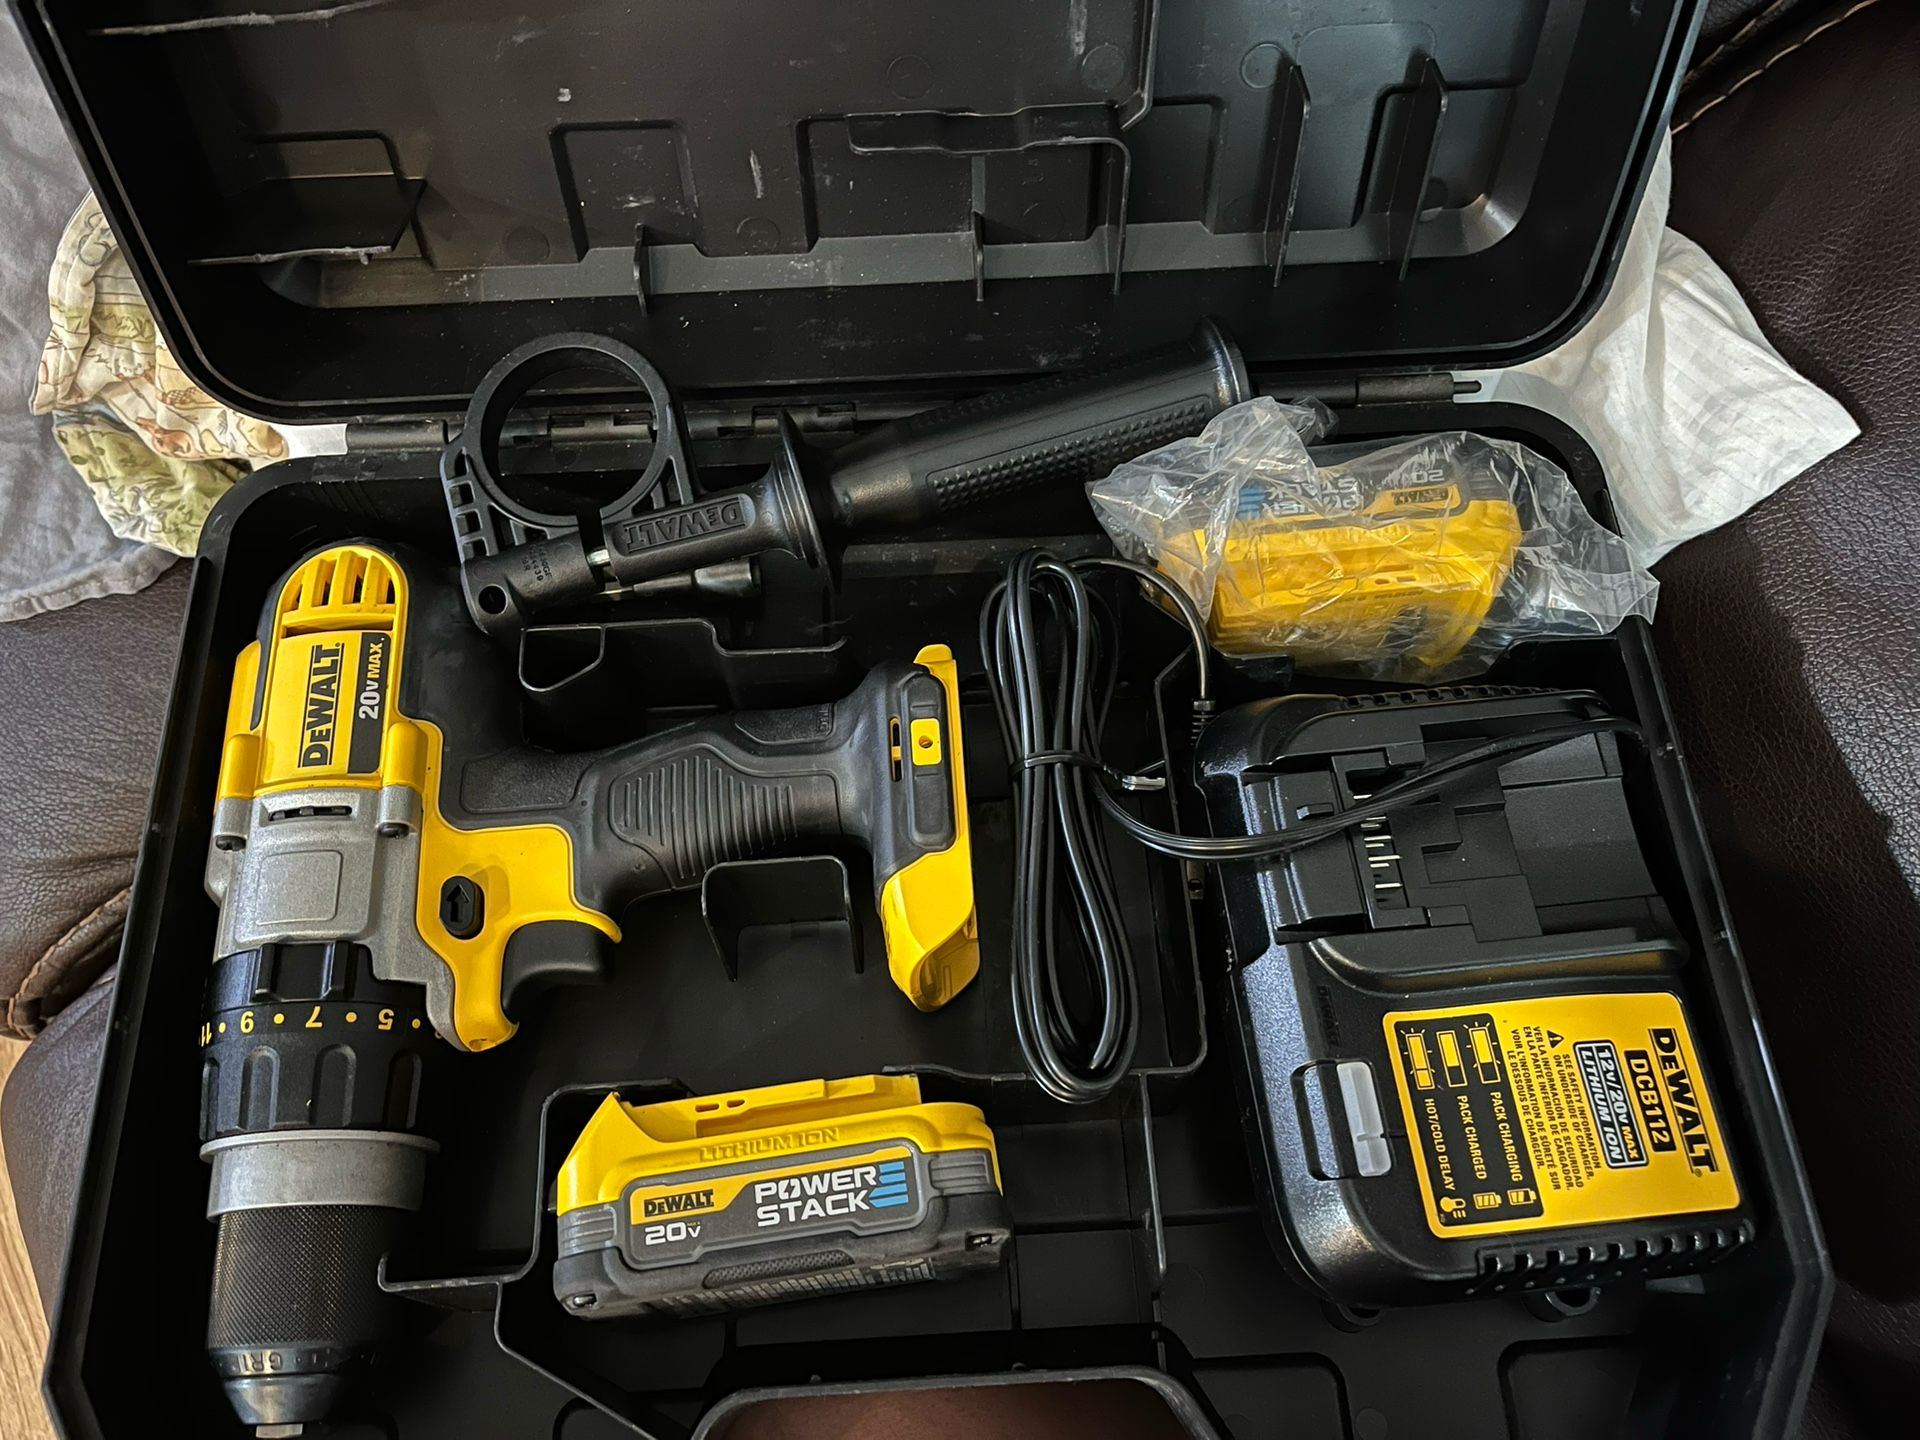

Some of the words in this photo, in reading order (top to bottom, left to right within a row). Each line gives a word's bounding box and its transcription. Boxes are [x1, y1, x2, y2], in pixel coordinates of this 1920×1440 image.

[625, 498, 745, 551] DEWALT
[367, 643, 383, 679] MAX
[300, 642, 343, 767] DEWALT
[240, 1011, 254, 1033] 9
[305, 1006, 323, 1028] 7
[378, 1009, 394, 1031] 5
[1523, 1026, 1532, 1037] EN
[1533, 1026, 1543, 1042] VER
[1507, 1050, 1516, 1060] LE
[1511, 1029, 1523, 1050] VOIR
[1527, 1039, 1536, 1051] LA
[1538, 1044, 1548, 1056] LA
[1530, 1052, 1544, 1079] PARTE
[1553, 1054, 1563, 1068] ON
[1510, 1061, 1528, 1102] DESSOUS
[1517, 1051, 1542, 1119] L'INFORMATION
[1542, 1056, 1566, 1120] INFORMACIÓN
[1556, 1068, 1577, 1119] UNDERSIDE
[1490, 1091, 1508, 1121] PACK
[1521, 1105, 1531, 1116] DE
[1538, 1081, 1556, 1122] INFERIOR
[1562, 1054, 1573, 1070] SEE
[1568, 1070, 1583, 1104] SAFETY
[1577, 1105, 1601, 1169] INFORMATION
[1581, 1050, 1611, 1122] LITHIUM
[1604, 1126, 1622, 1160] ION
[1630, 1058, 1670, 1144] DCB112
[1649, 1028, 1719, 1173] DEWALT
[700, 1134, 793, 1162] LITHIUM
[800, 1127, 840, 1148] ION
[1424, 1098, 1447, 1153] HOT/COLD
[1438, 1155, 1456, 1191] DELAY
[1456, 1095, 1473, 1125] PACK
[1465, 1125, 1488, 1180] CHARGED
[1525, 1118, 1545, 1169] CHARGEUR.
[1535, 1121, 1546, 1133] DE
[1549, 1124, 1561, 1136] DE
[1559, 1121, 1568, 1133] DE
[1571, 1121, 1582, 1134] OF
[1621, 1126, 1639, 1159] MAX
[1498, 1122, 1524, 1182] CHARGING
[1540, 1133, 1556, 1169] SÛRETÉ
[1553, 1137, 1575, 1191] CARGADOR.
[1563, 1133, 1585, 1188] SEGURIDAD
[1576, 1133, 1595, 1180] CHARGER.
[755, 1165, 877, 1204] POWER
[1549, 1171, 1561, 1190] SUR
[644, 1189, 714, 1217] DEWALT
[756, 1189, 871, 1227] STACK
